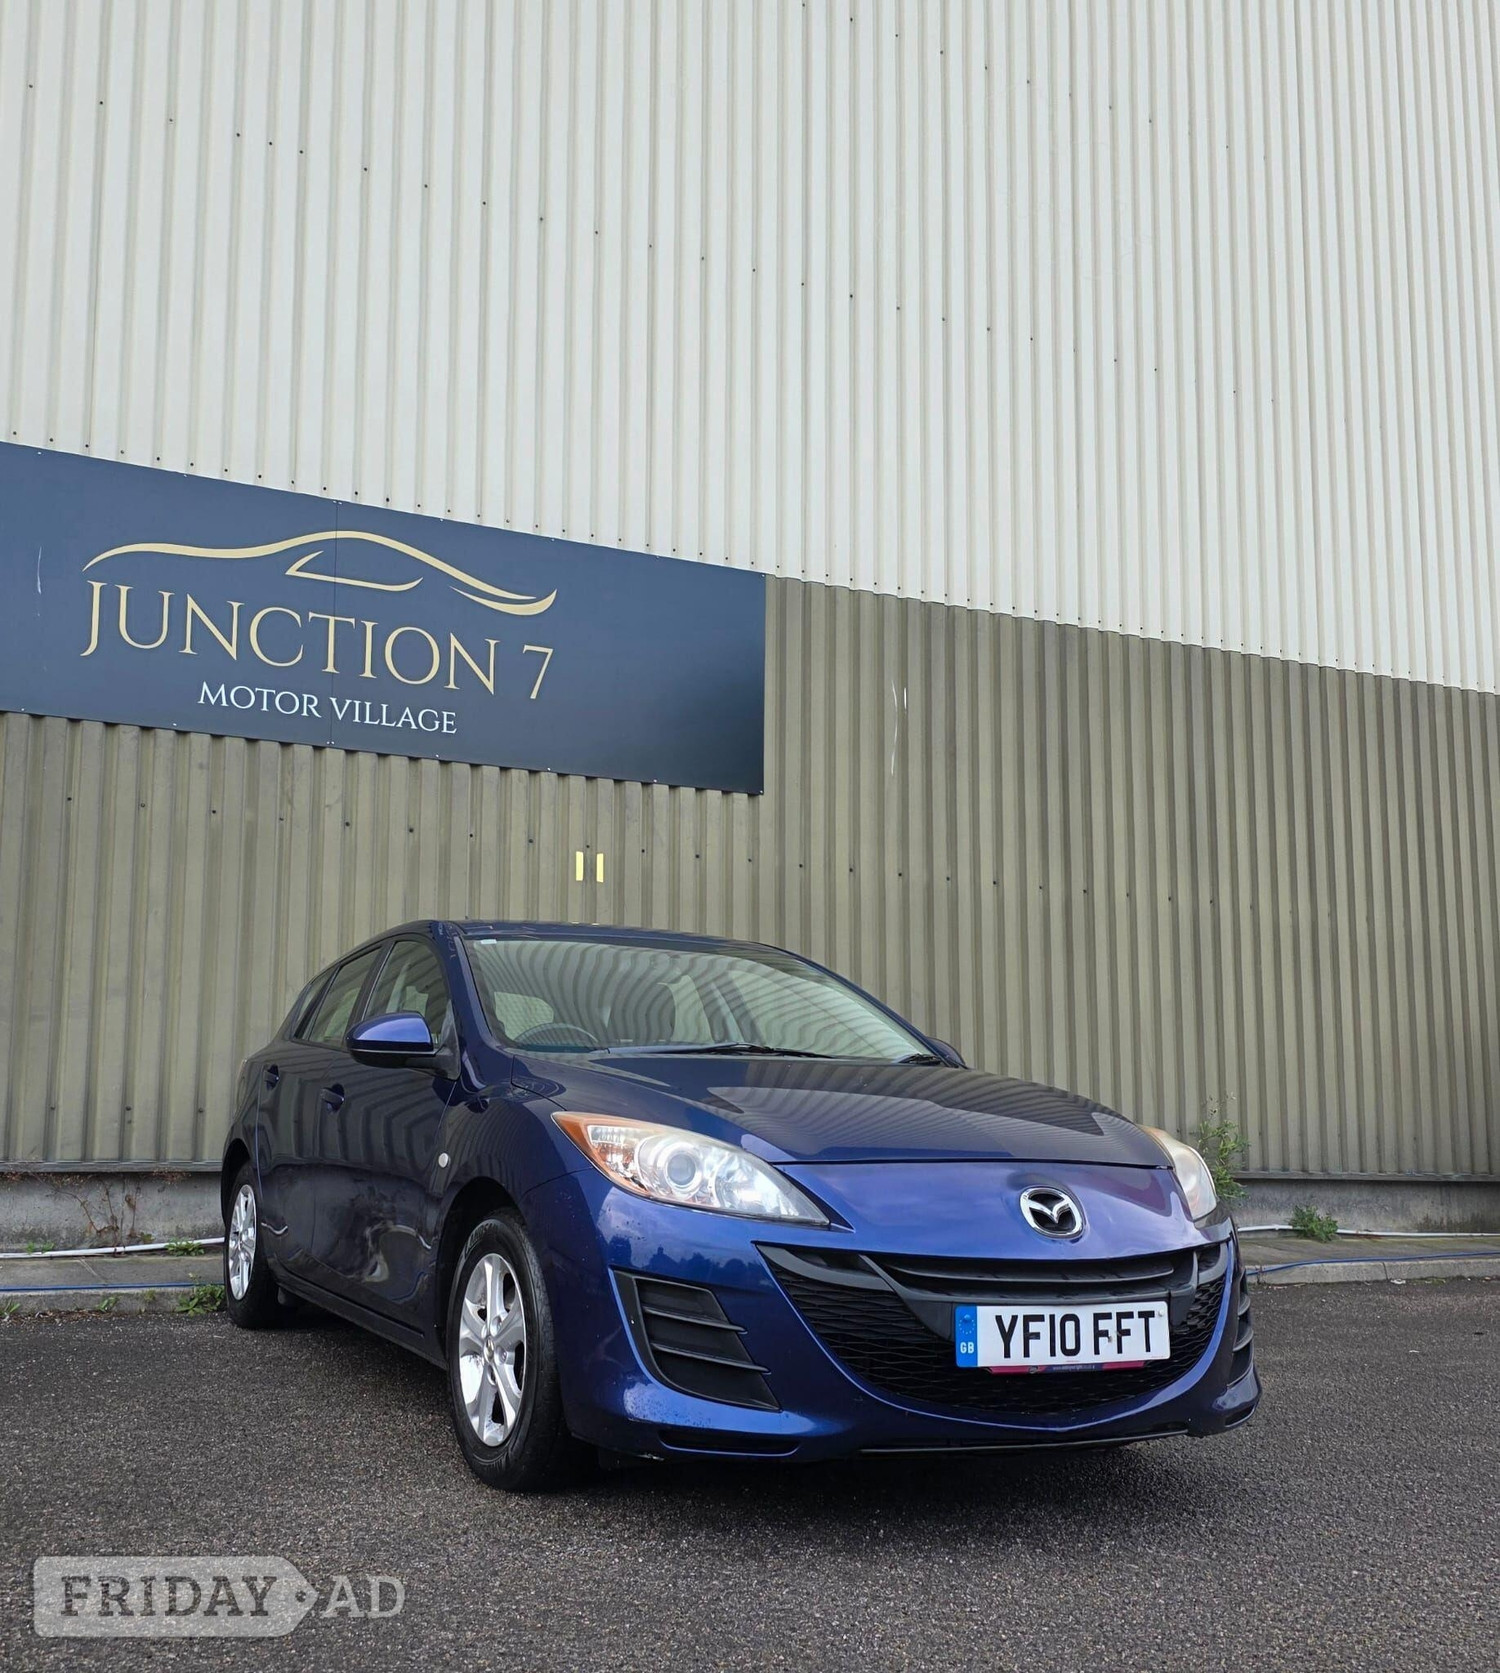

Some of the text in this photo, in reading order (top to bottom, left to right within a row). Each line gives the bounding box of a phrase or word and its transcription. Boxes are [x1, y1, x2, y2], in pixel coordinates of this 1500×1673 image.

[80, 580, 554, 699] JUNCTION 7
[197, 681, 457, 734] MOTOR VILLAGE
[960, 1341, 975, 1354] GB
[995, 1310, 1155, 1359] YF10 FFT
